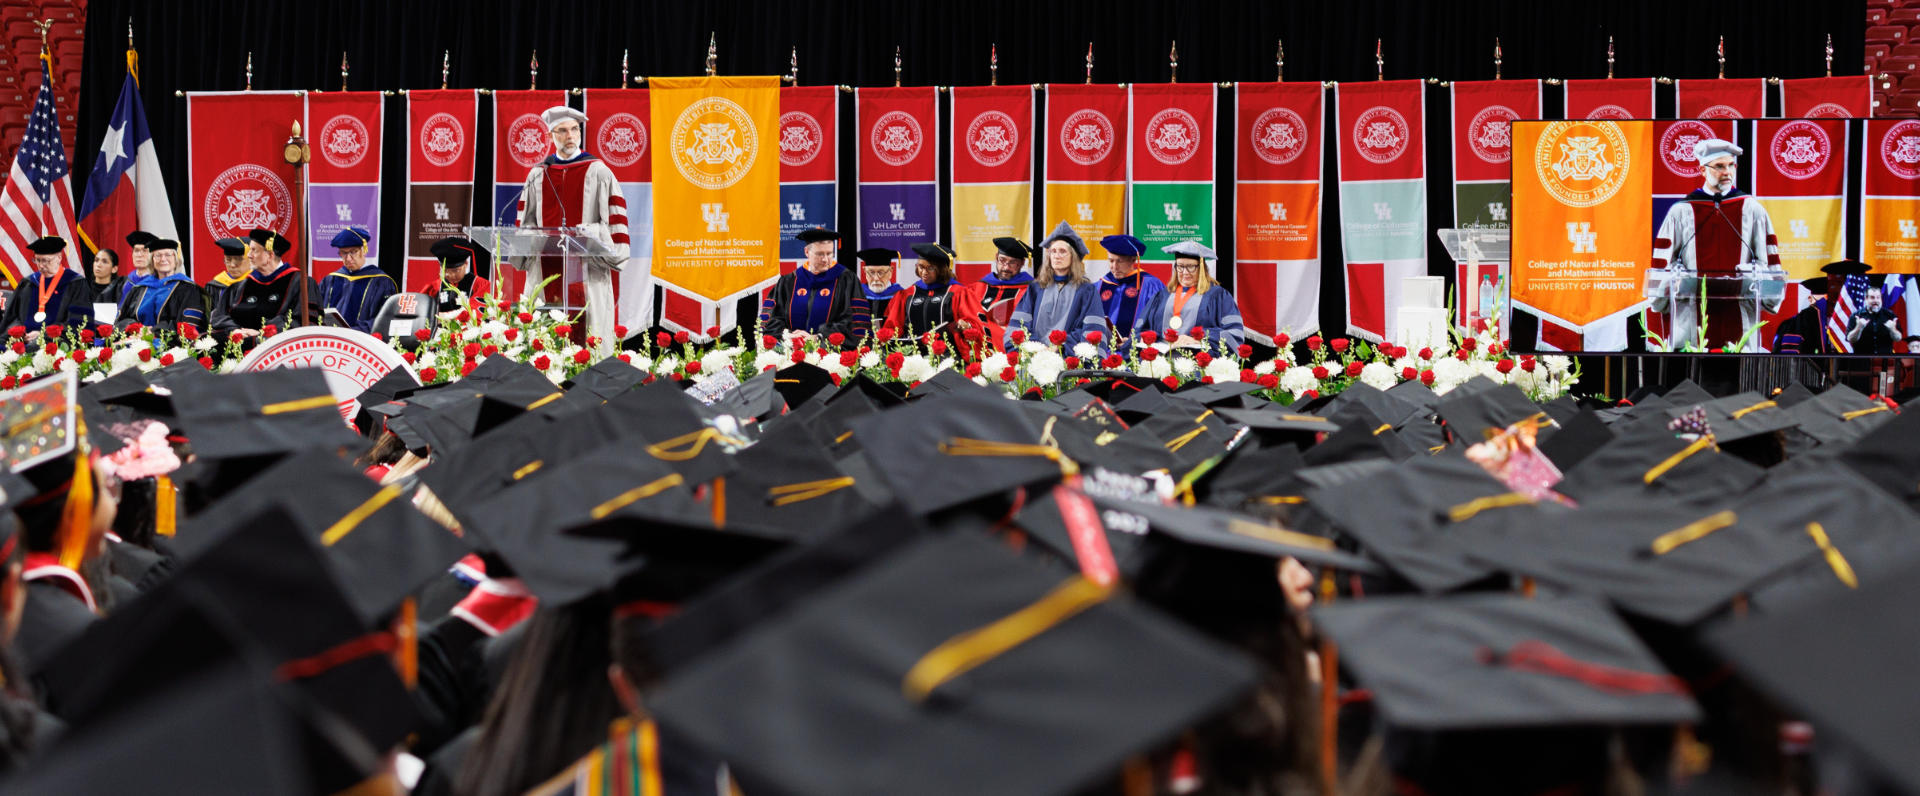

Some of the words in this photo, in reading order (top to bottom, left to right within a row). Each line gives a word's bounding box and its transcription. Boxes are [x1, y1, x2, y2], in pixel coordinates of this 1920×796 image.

[677, 104, 711, 153] UNIVERSITY
[728, 109, 751, 152] HOUSTON
[1598, 121, 1624, 168] HOUSTON
[684, 162, 721, 182] FOUNDED
[211, 171, 245, 218] UNIVERSITY
[262, 176, 285, 218] HOUSTON
[1550, 178, 1590, 200] FOUNDED
[1593, 178, 1614, 200] 1927
[701, 203, 730, 232] UH
[665, 239, 690, 249] College
[695, 239, 703, 247] of
[704, 239, 731, 247] Natural
[733, 238, 763, 247] Sciences
[1566, 222, 1597, 253] UH
[699, 247, 745, 255] Mathematics
[666, 260, 712, 268] UNIVERSITY
[1528, 260, 1557, 270] College
[1559, 260, 1568, 268] of
[1569, 260, 1599, 268] Natural
[1601, 260, 1635, 268] Sciences
[1564, 269, 1616, 277] Mathematics
[1528, 282, 1579, 290] UNIVERSITY
[1580, 282, 1591, 290] OF
[1593, 281, 1635, 289] HOUSTON
[398, 294, 418, 315] UH
[323, 355, 351, 369] OF
